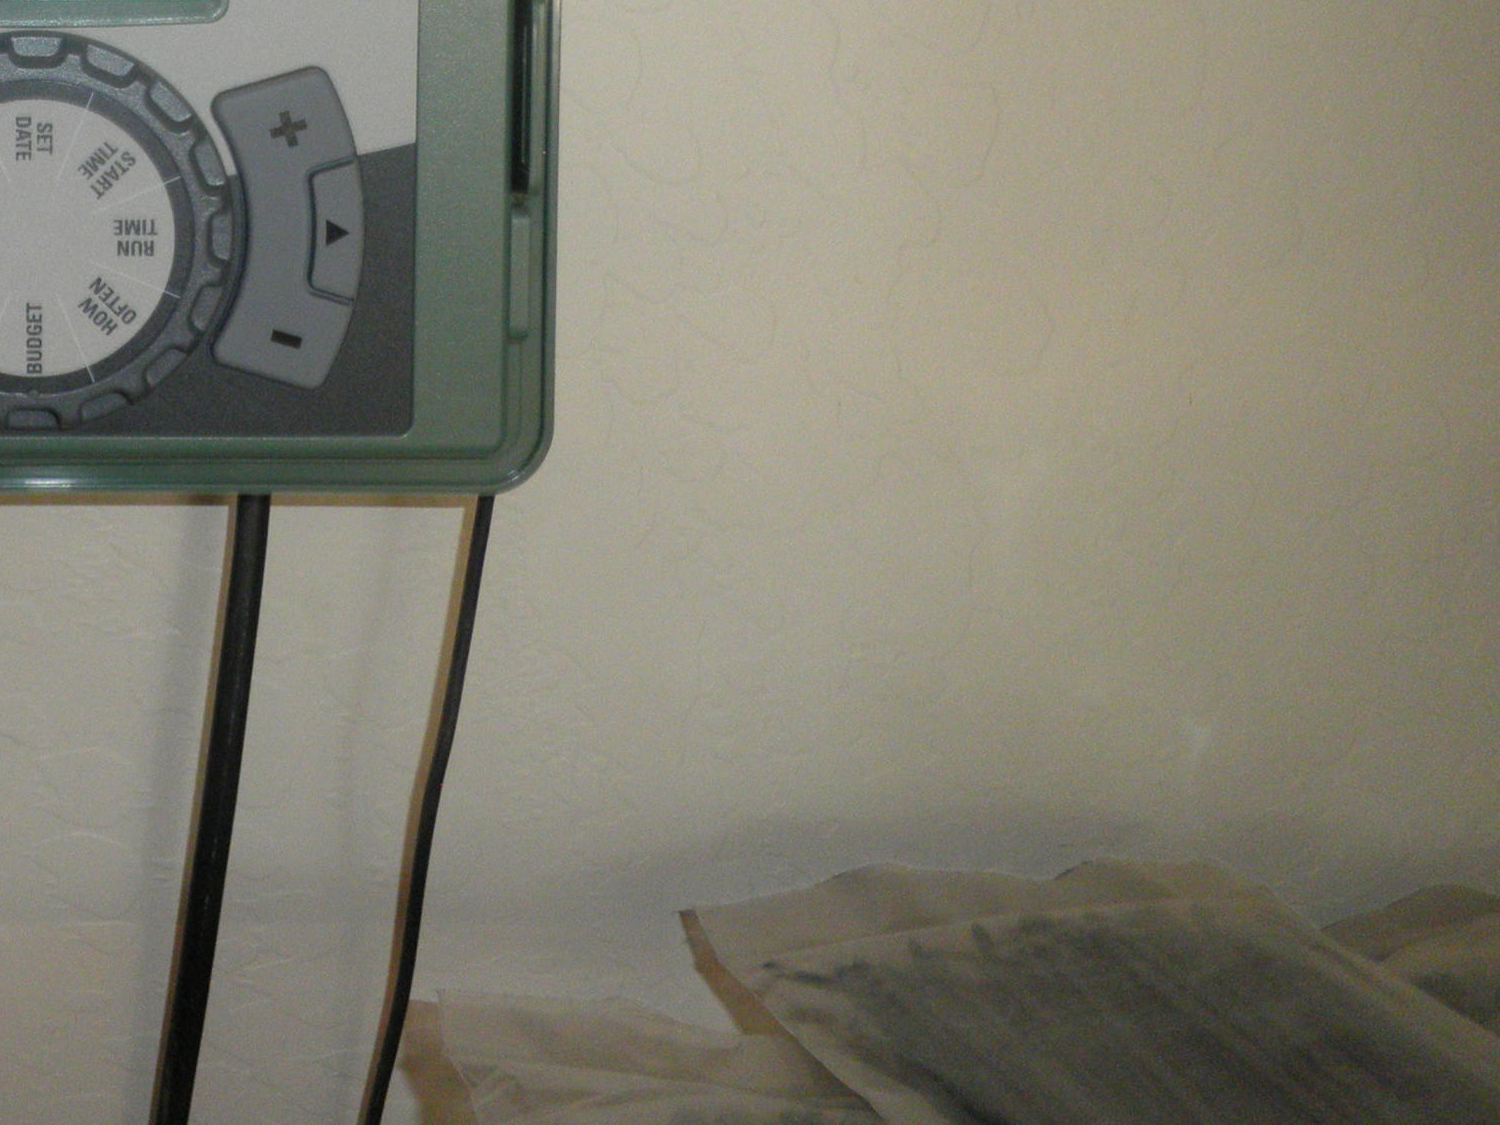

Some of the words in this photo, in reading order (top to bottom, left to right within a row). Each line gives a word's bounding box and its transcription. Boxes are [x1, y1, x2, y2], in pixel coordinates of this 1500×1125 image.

[15, 116, 32, 161] DATE
[36, 122, 53, 156] SET
[77, 141, 119, 180] TIME
[89, 150, 137, 200] START
[113, 219, 158, 236] TIME
[116, 239, 155, 257] RUN
[77, 297, 119, 337] HOW
[88, 276, 138, 326] OFTEN
[25, 302, 43, 375] BUDGET
